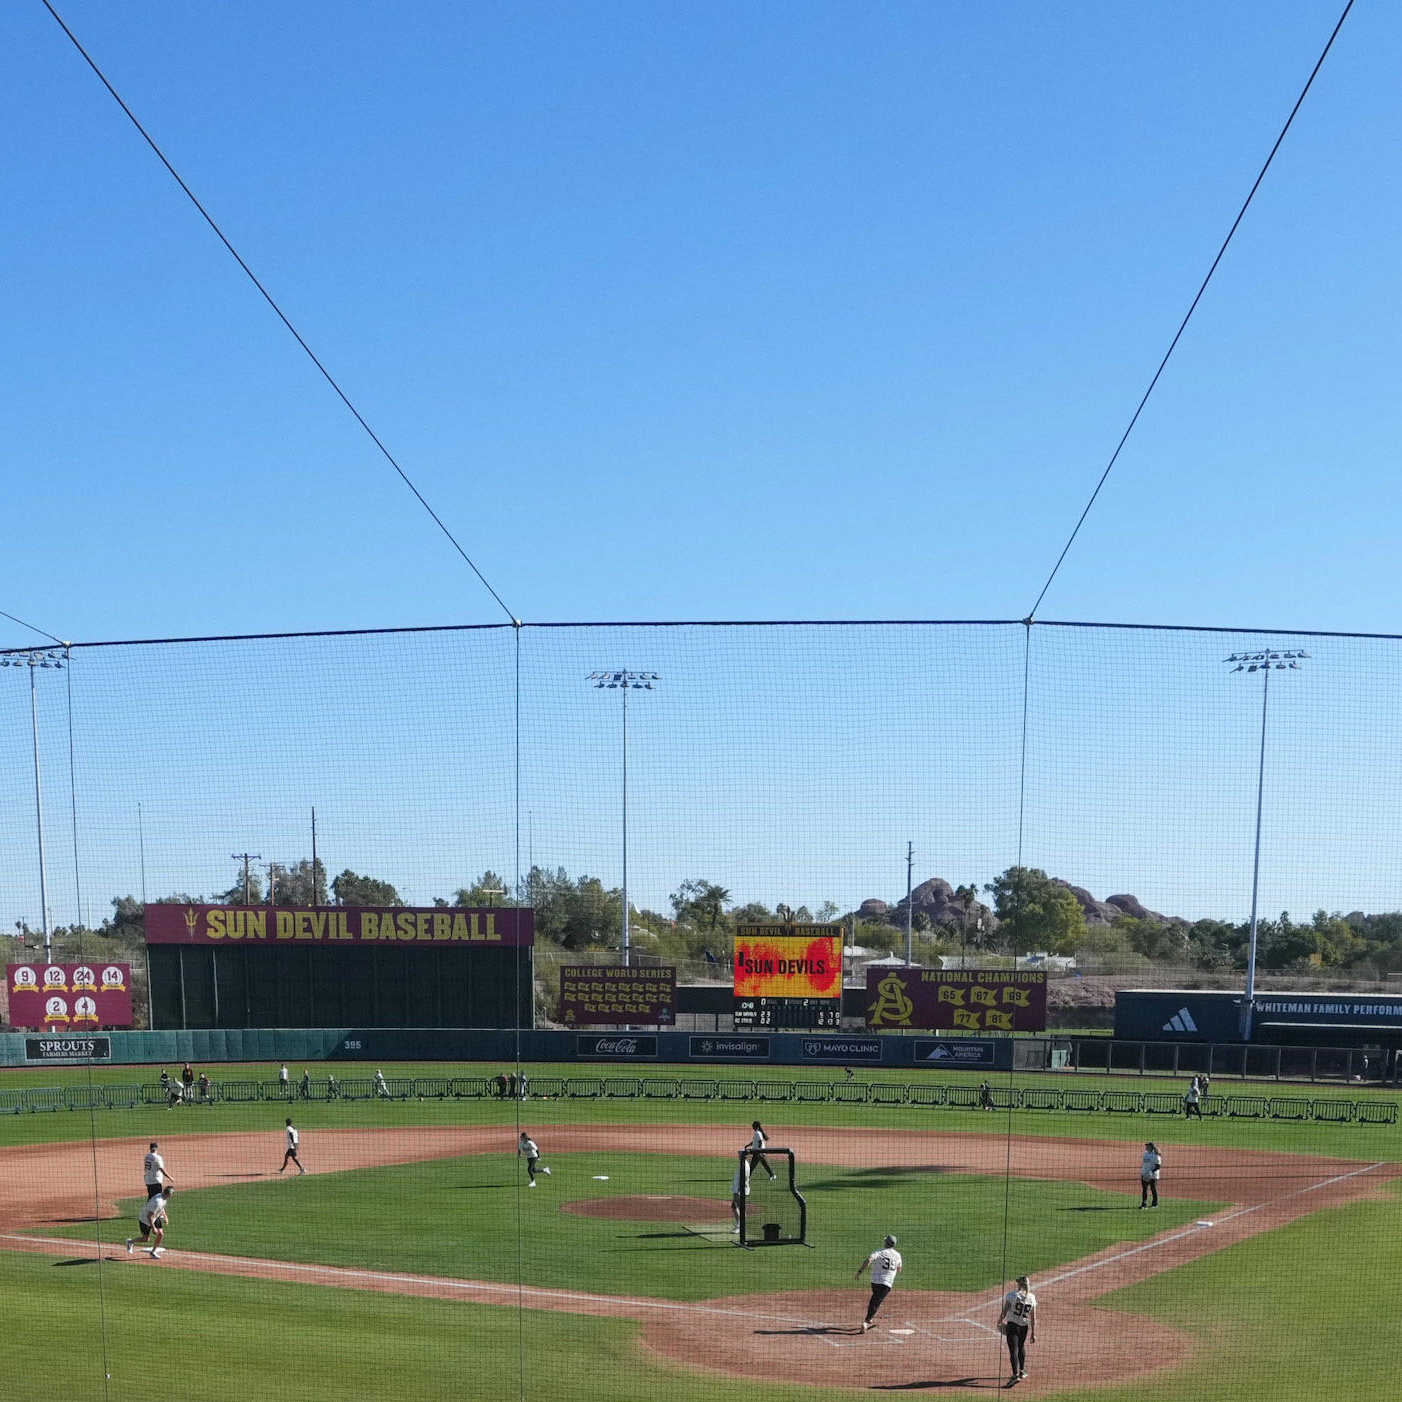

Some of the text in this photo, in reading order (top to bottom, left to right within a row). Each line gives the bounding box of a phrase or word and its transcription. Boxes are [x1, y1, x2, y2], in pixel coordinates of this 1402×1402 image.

[206, 909, 502, 941] SUN DEVIL BASEBALL
[740, 926, 835, 936] SUN DEVIL BASEBALL
[745, 959, 825, 974] SUN DEVILS
[21, 971, 29, 981] 9
[49, 971, 60, 981] 12
[77, 970, 91, 980] 24
[107, 971, 118, 981] 14
[565, 968, 672, 978] COLLEGE WORLD SERIES
[921, 971, 1044, 983] NATIONAL CHAMPIONS
[53, 1001, 60, 1012] 2
[1256, 1003, 1311, 1013] WHITEMAN
[1313, 1005, 1351, 1014] FAMILY
[40, 1040, 95, 1051] SPROUTS
[344, 1040, 362, 1050] 395
[716, 1041, 758, 1053] invisalign
[823, 1044, 879, 1053] MAYO CLINIC
[953, 1045, 984, 1053] MOUNTAIN
